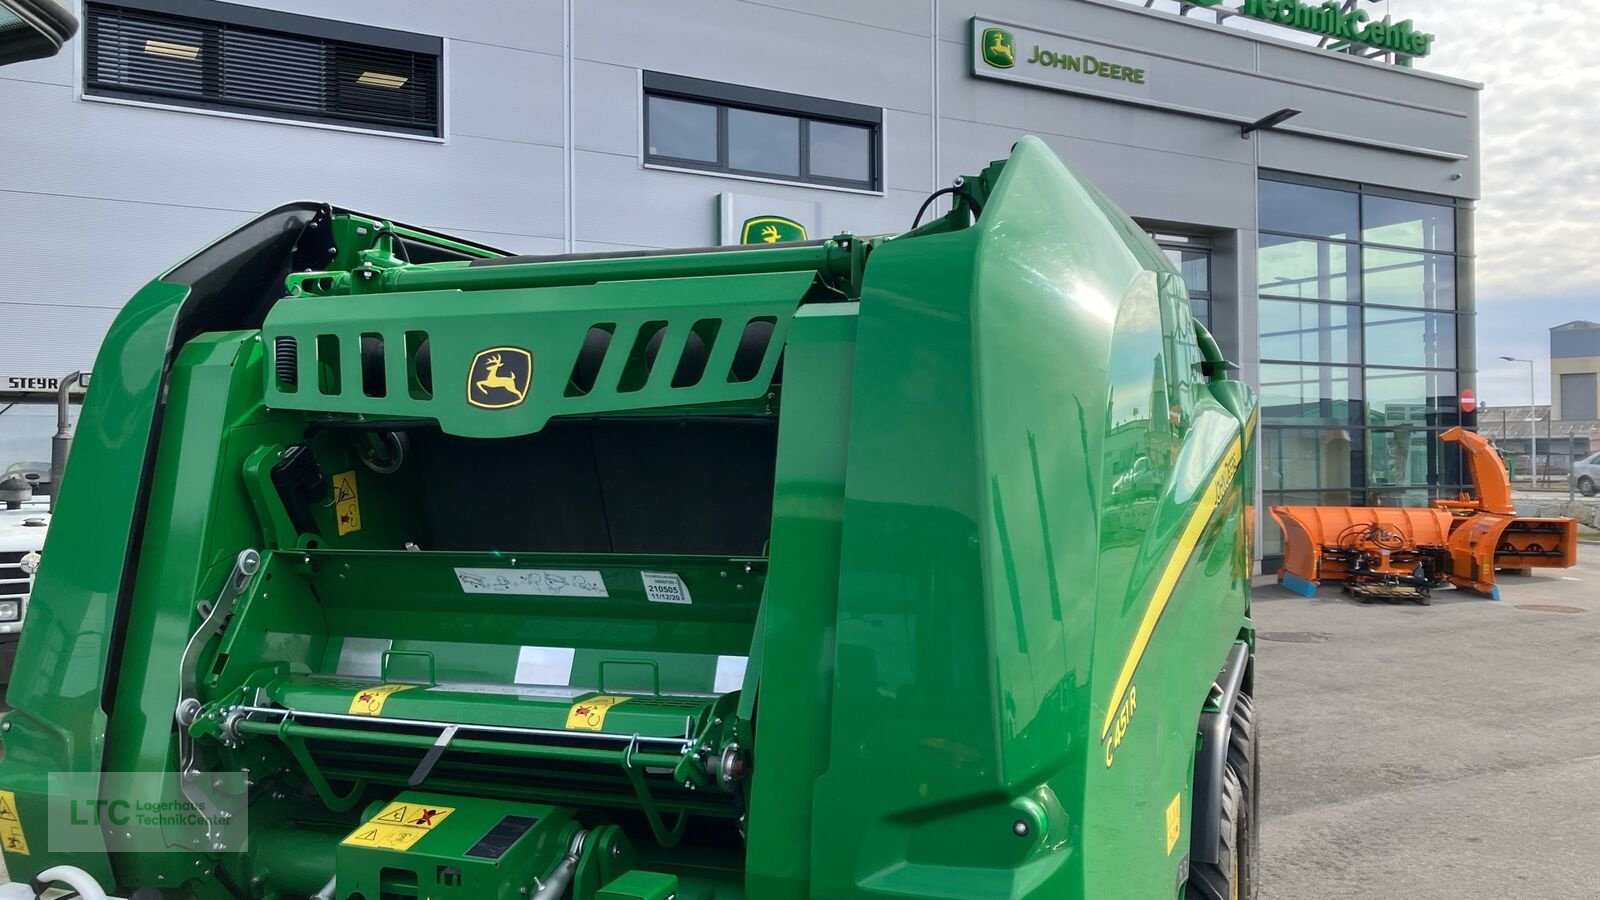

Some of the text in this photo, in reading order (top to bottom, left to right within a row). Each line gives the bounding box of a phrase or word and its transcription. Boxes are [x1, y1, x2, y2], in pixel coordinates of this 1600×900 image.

[1243, 0, 1434, 55] TechnikCenter
[1027, 45, 1145, 84] JOHN DEERE
[9, 377, 58, 389] STEYR
[648, 585, 679, 594] 210505
